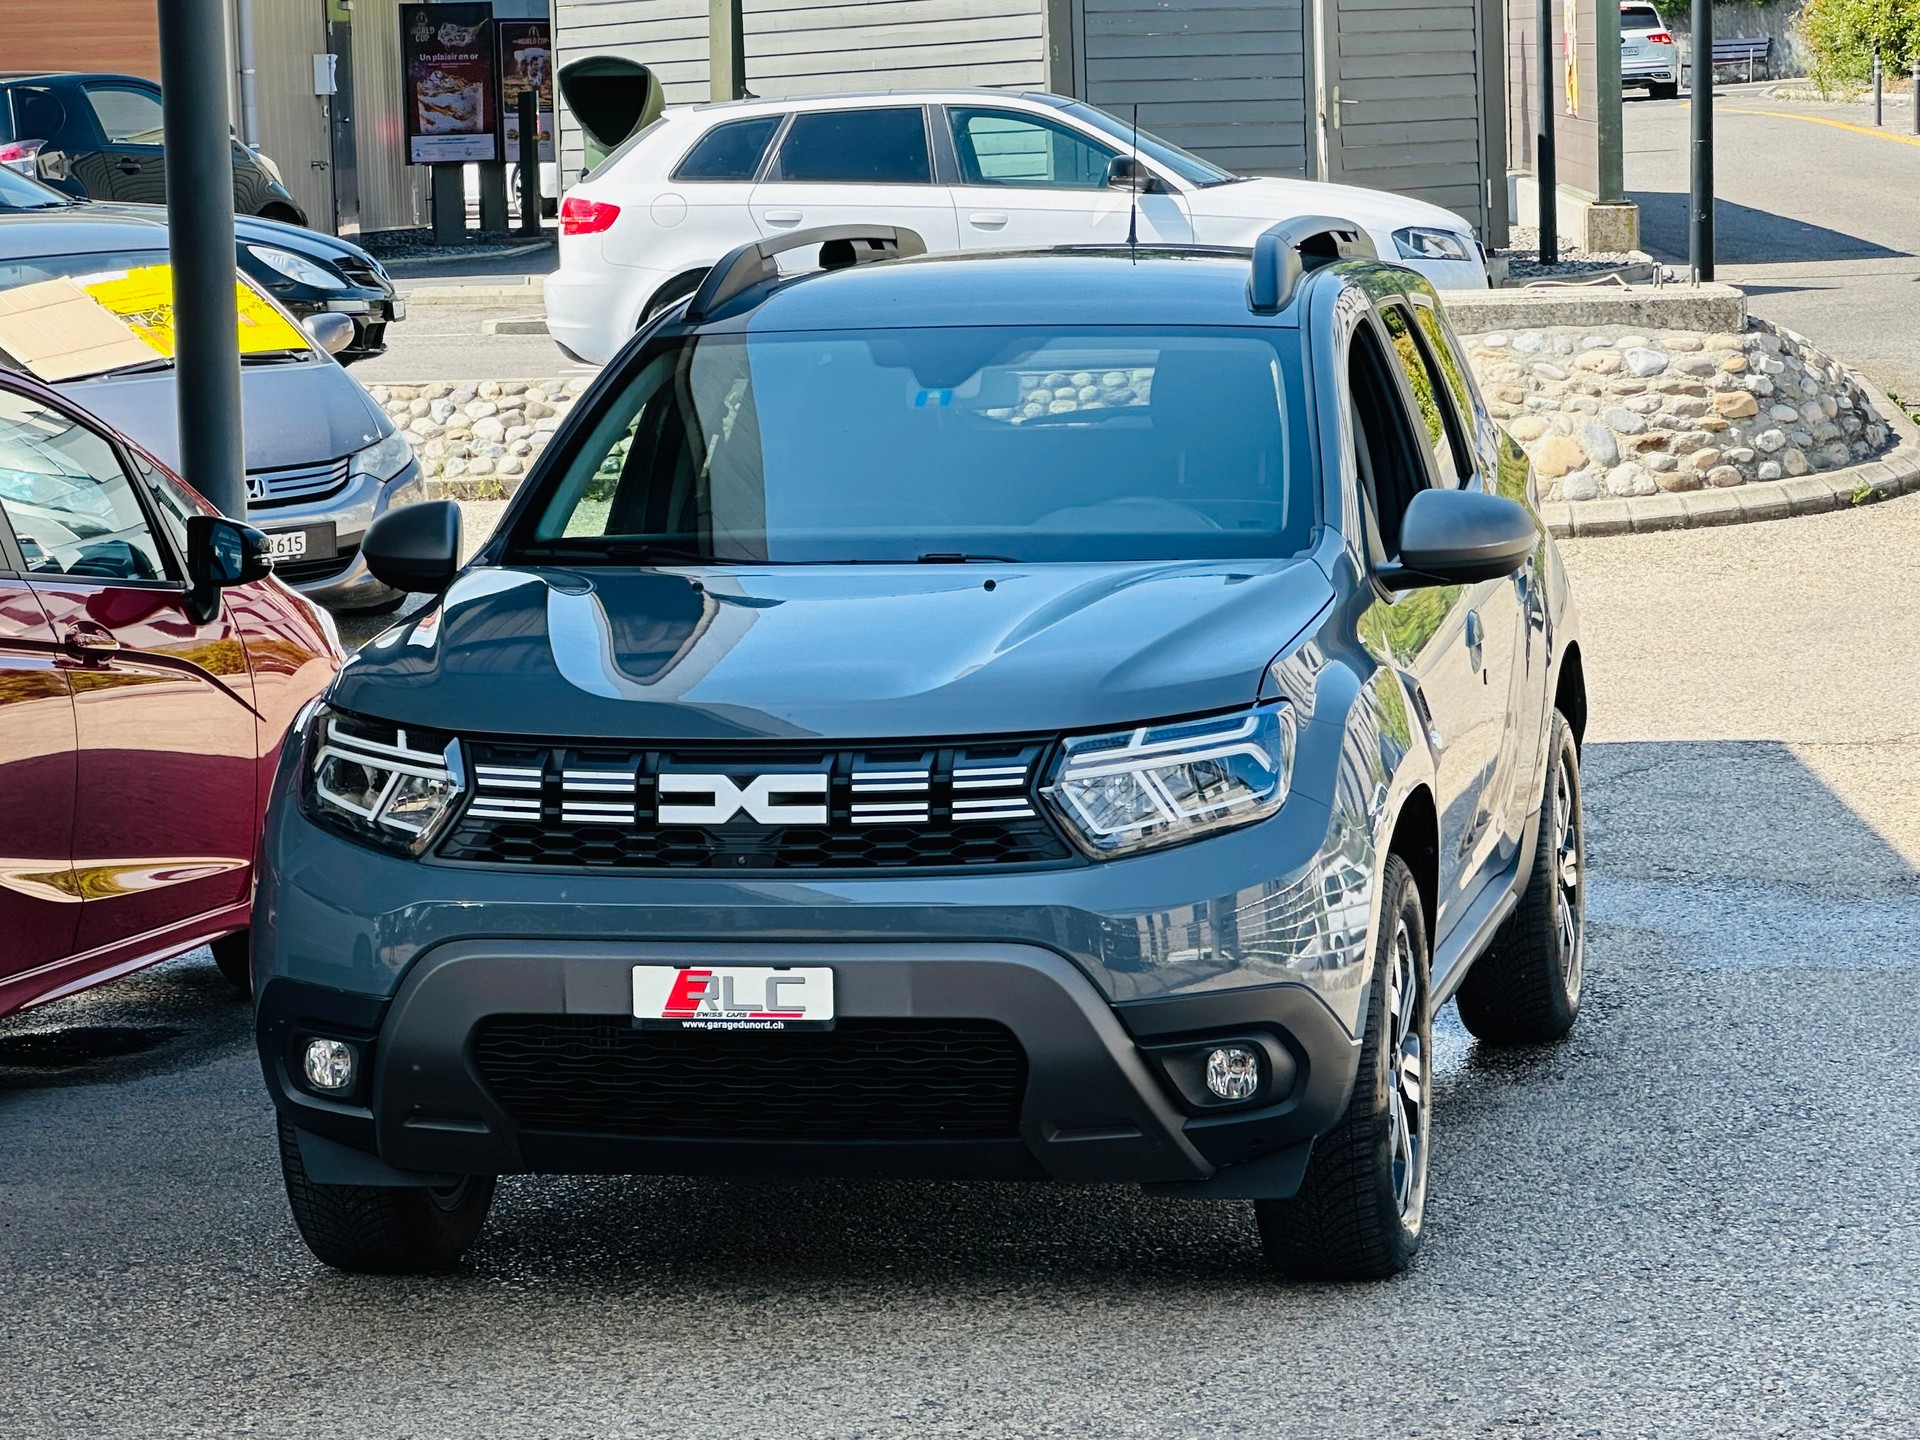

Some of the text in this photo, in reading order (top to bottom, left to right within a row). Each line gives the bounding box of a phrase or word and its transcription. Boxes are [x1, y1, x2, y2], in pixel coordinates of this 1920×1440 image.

[415, 34, 430, 42] CUP
[420, 53, 431, 61] Un
[432, 53, 457, 62] plaisir
[682, 1020, 785, 1030] www.garagedunord.ch
